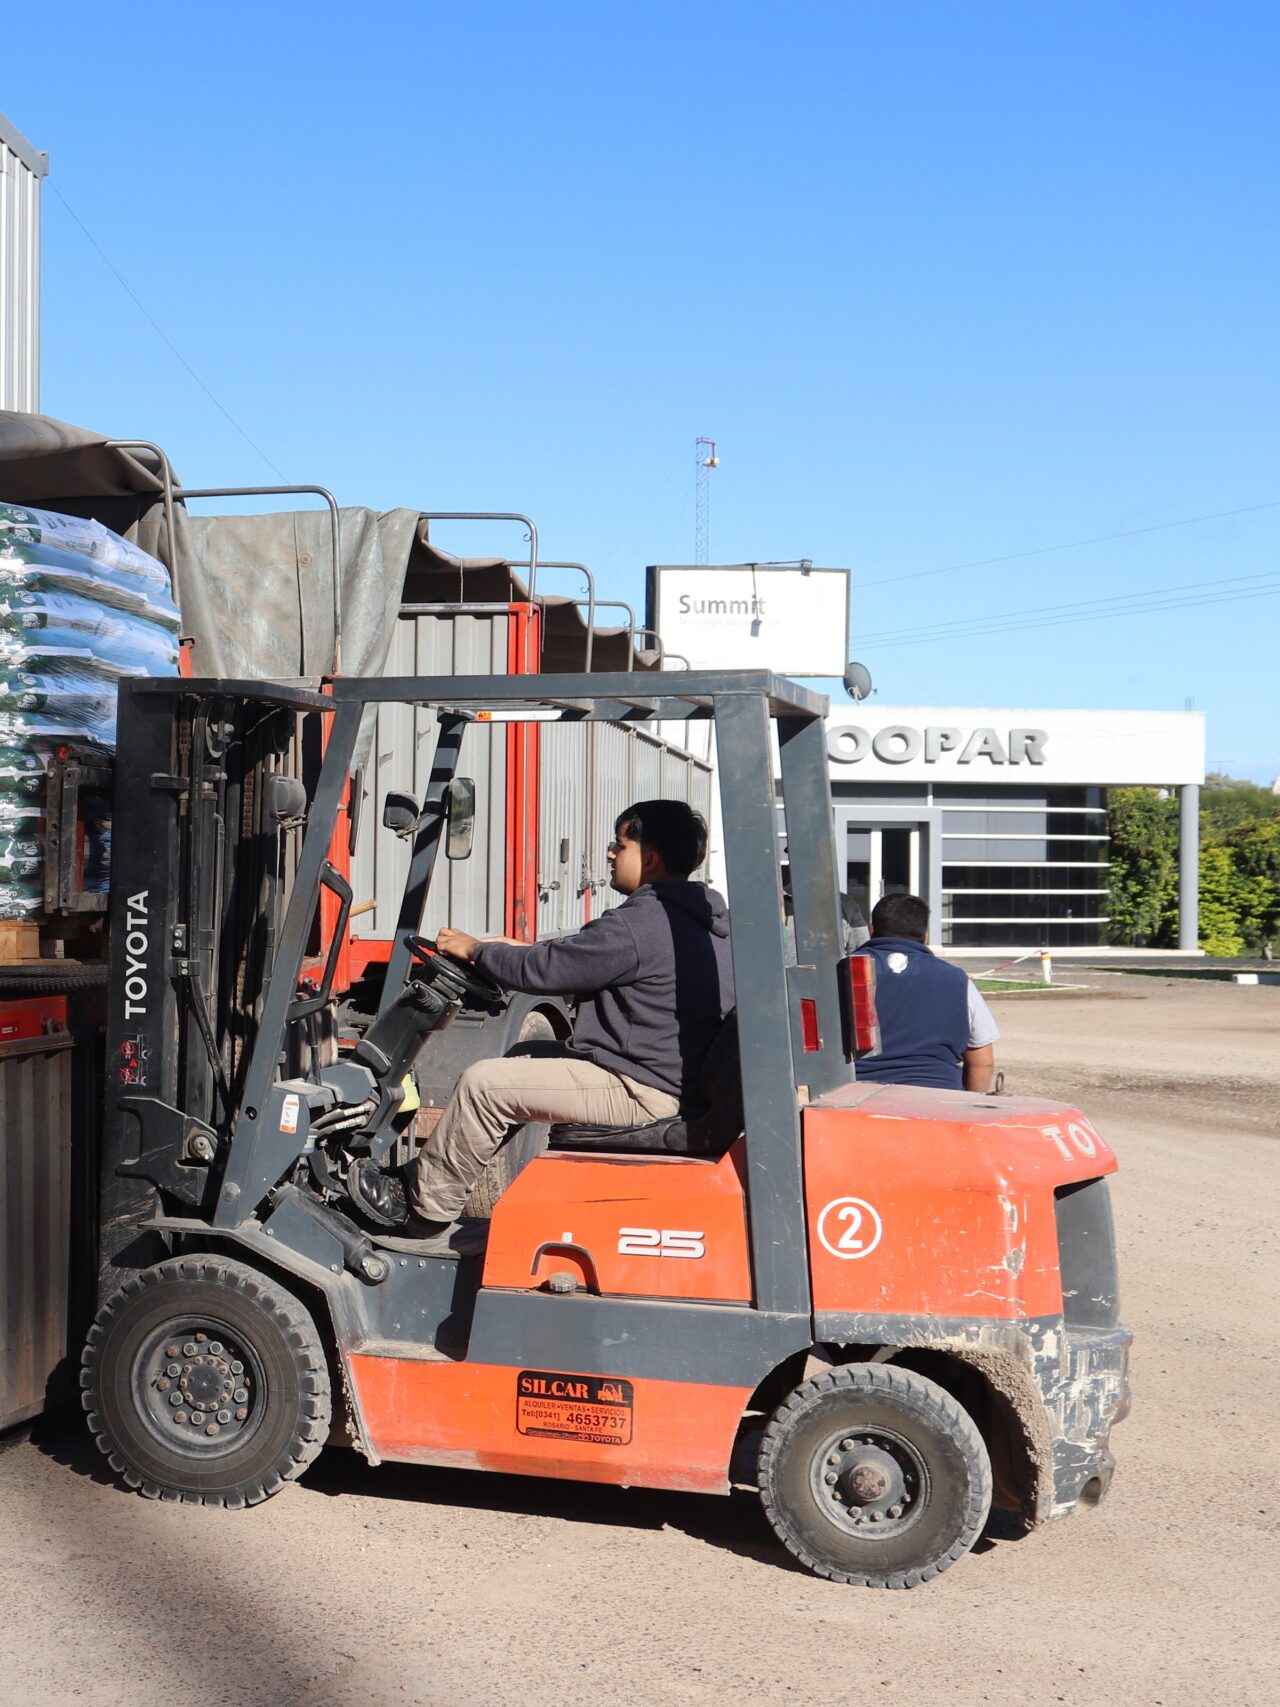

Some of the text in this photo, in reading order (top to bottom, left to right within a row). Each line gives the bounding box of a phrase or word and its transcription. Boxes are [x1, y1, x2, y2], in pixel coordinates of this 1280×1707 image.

[679, 594, 766, 615] Summit
[826, 724, 1049, 765] OOPAR
[124, 890, 149, 1020] TOYOTA
[837, 1206, 863, 1249] 2
[618, 1227, 706, 1259] 25
[521, 1378, 589, 1399] SILCAR
[524, 1400, 557, 1410] ALQUILER
[591, 1405, 625, 1416] SERVICIOS
[543, 1421, 570, 1430] ROSARIO
[566, 1413, 626, 1429] 4653737
[590, 1434, 621, 1444] TOYOTA
